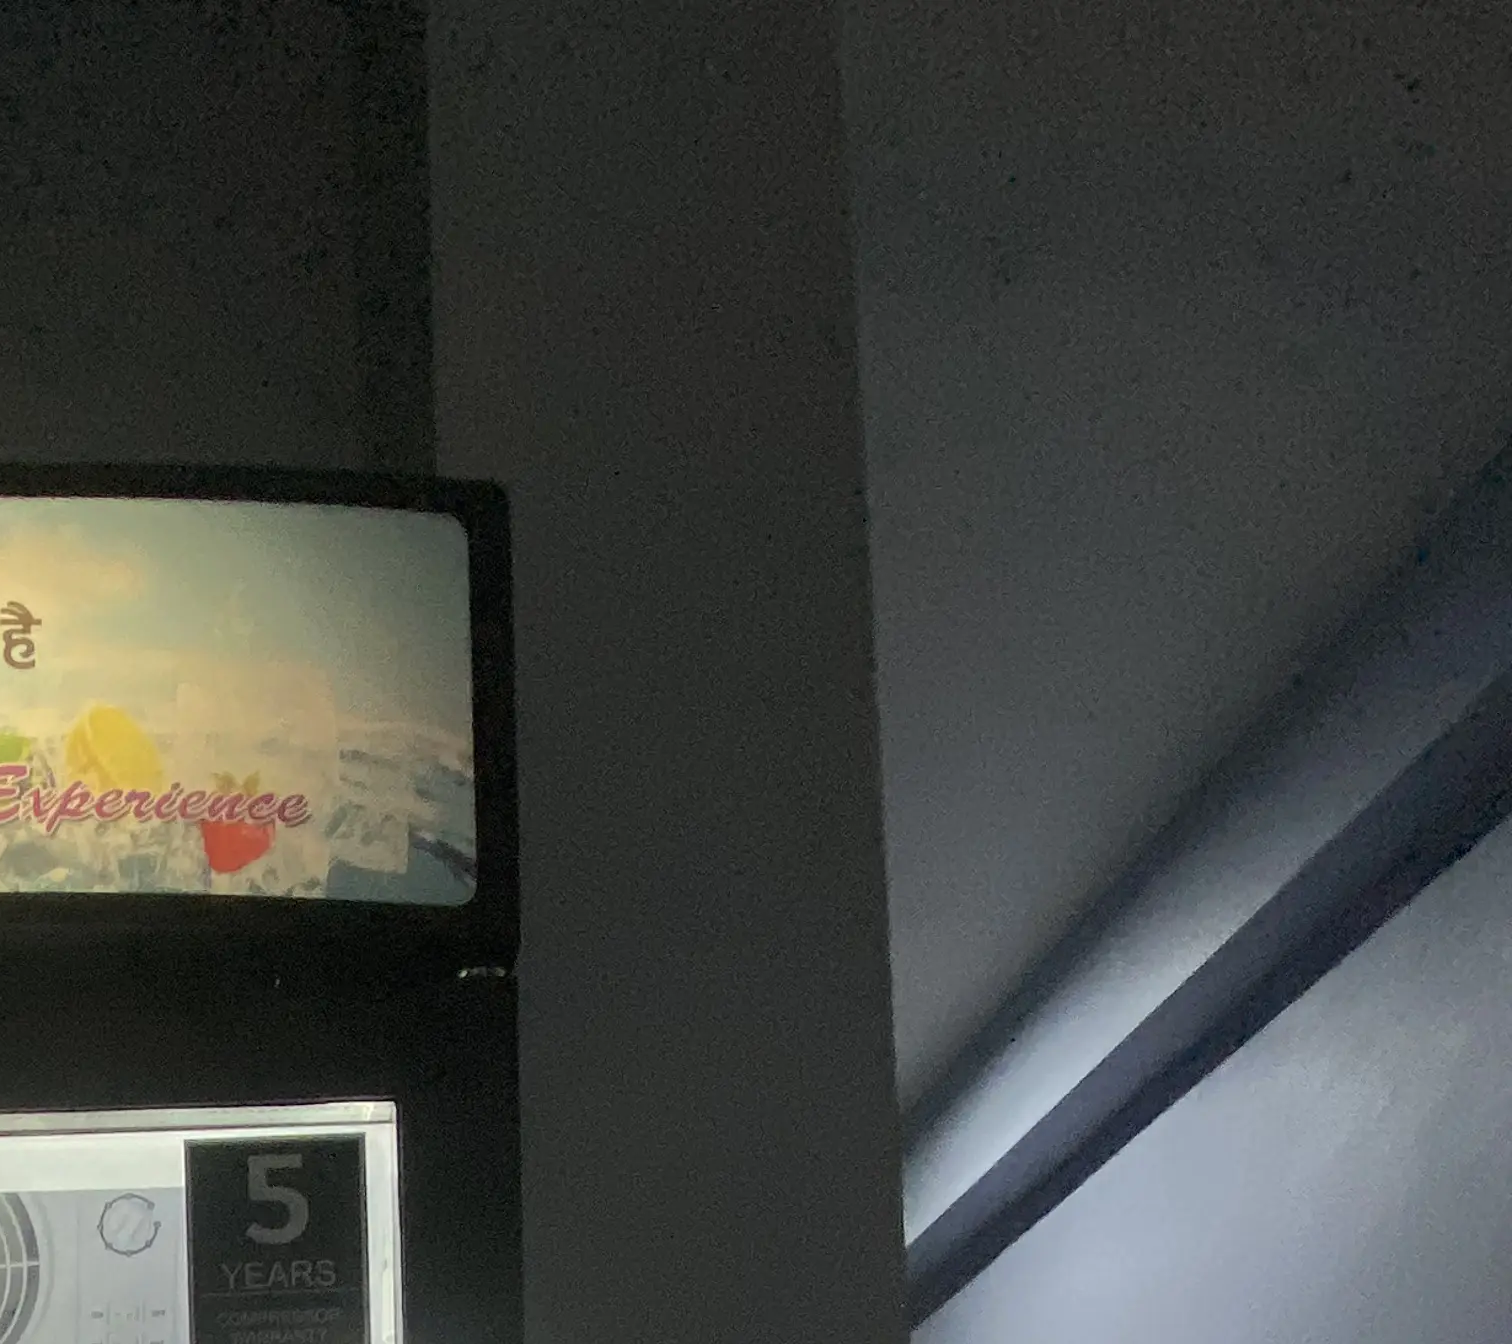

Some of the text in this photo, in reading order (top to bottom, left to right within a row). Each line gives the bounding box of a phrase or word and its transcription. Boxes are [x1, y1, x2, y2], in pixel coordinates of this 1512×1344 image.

[0, 601, 42, 669] है
[245, 1153, 310, 1245] 5
[220, 1259, 337, 1289] YEARS
